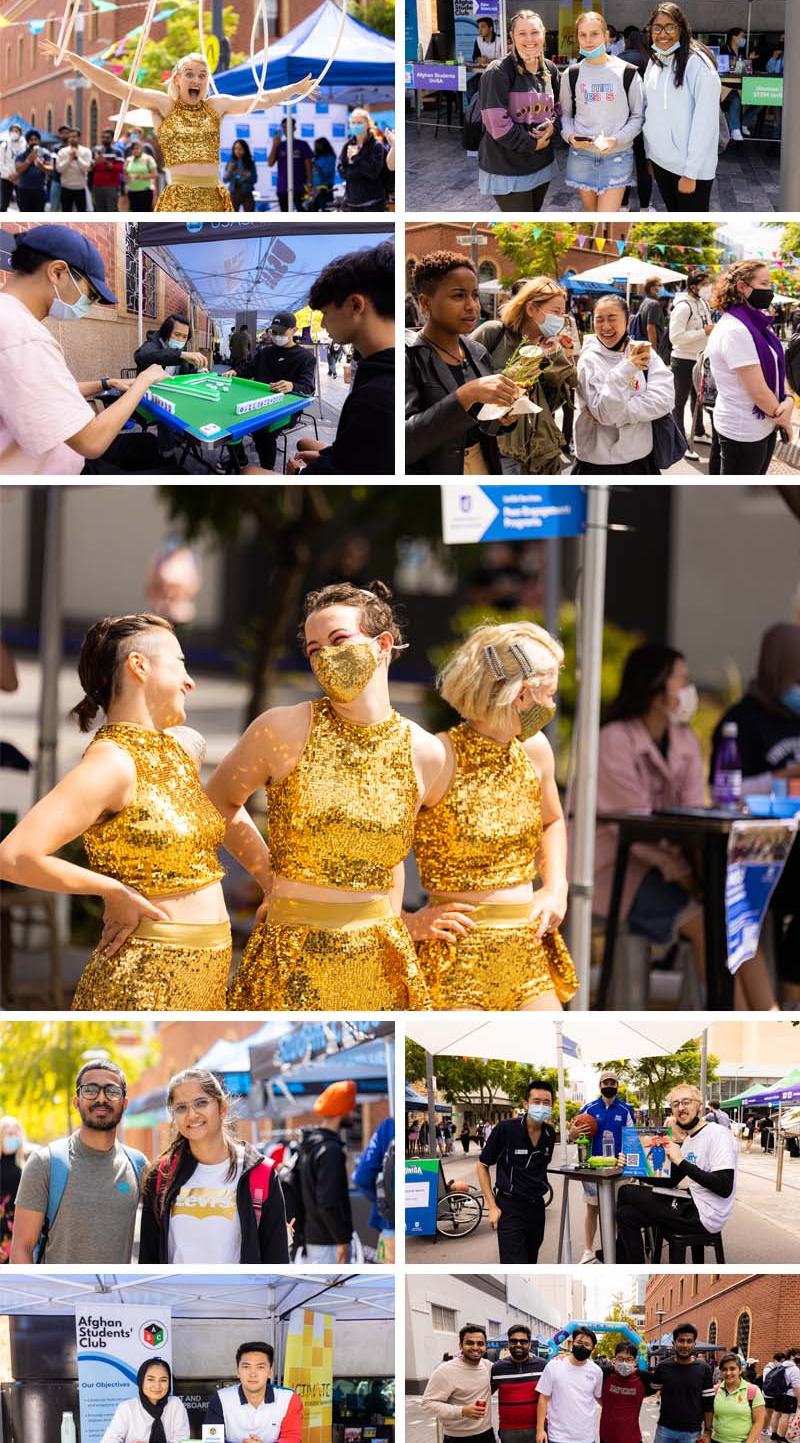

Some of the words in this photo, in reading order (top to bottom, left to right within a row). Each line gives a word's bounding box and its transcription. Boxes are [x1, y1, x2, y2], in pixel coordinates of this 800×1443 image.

[78, 1315, 122, 1330] Afghan
[79, 1327, 133, 1338] Students'
[79, 1338, 107, 1348] Club
